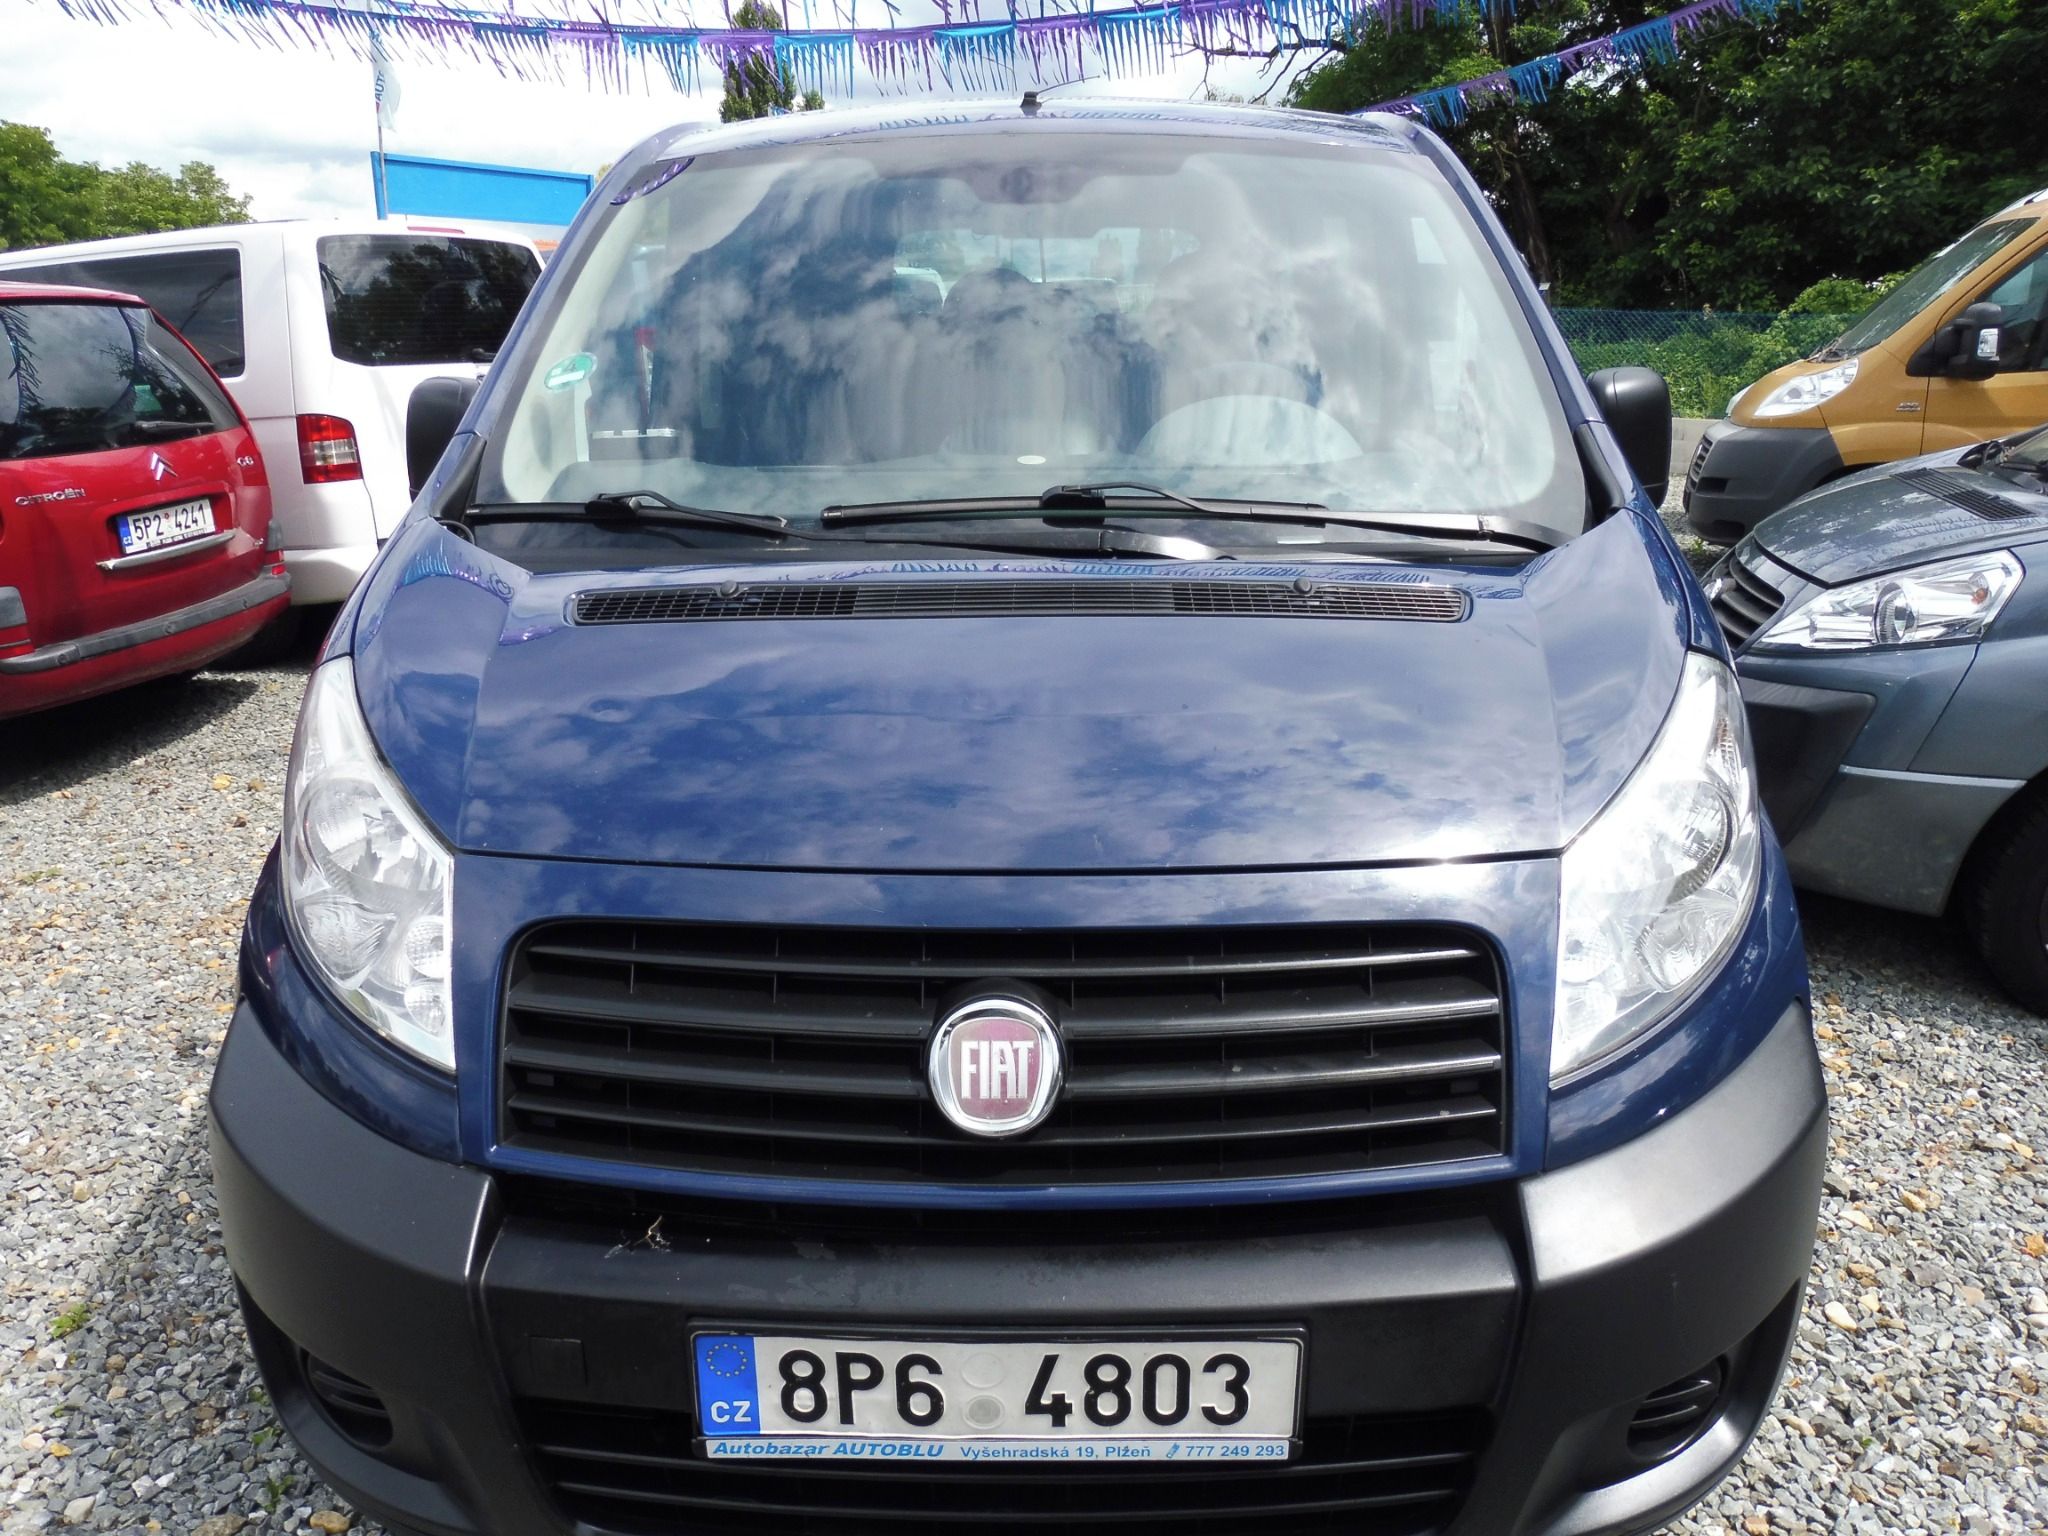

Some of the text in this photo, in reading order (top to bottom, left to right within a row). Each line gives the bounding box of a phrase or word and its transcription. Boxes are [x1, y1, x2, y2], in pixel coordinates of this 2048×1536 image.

[132, 514, 164, 541] 5P2
[175, 503, 207, 531] 4241
[961, 1040, 1034, 1099] FIAT
[778, 1349, 1251, 1427] 8P6 4803
[710, 1400, 752, 1423] CZ
[713, 1442, 829, 1456] Autobazar
[832, 1443, 944, 1457] AUTOBLU
[960, 1446, 1070, 1460] Vyšehradská
[1075, 1446, 1099, 1459] 19,
[1185, 1446, 1215, 1457] 777
[1220, 1445, 1250, 1457] 249
[1255, 1445, 1285, 1457] 293
